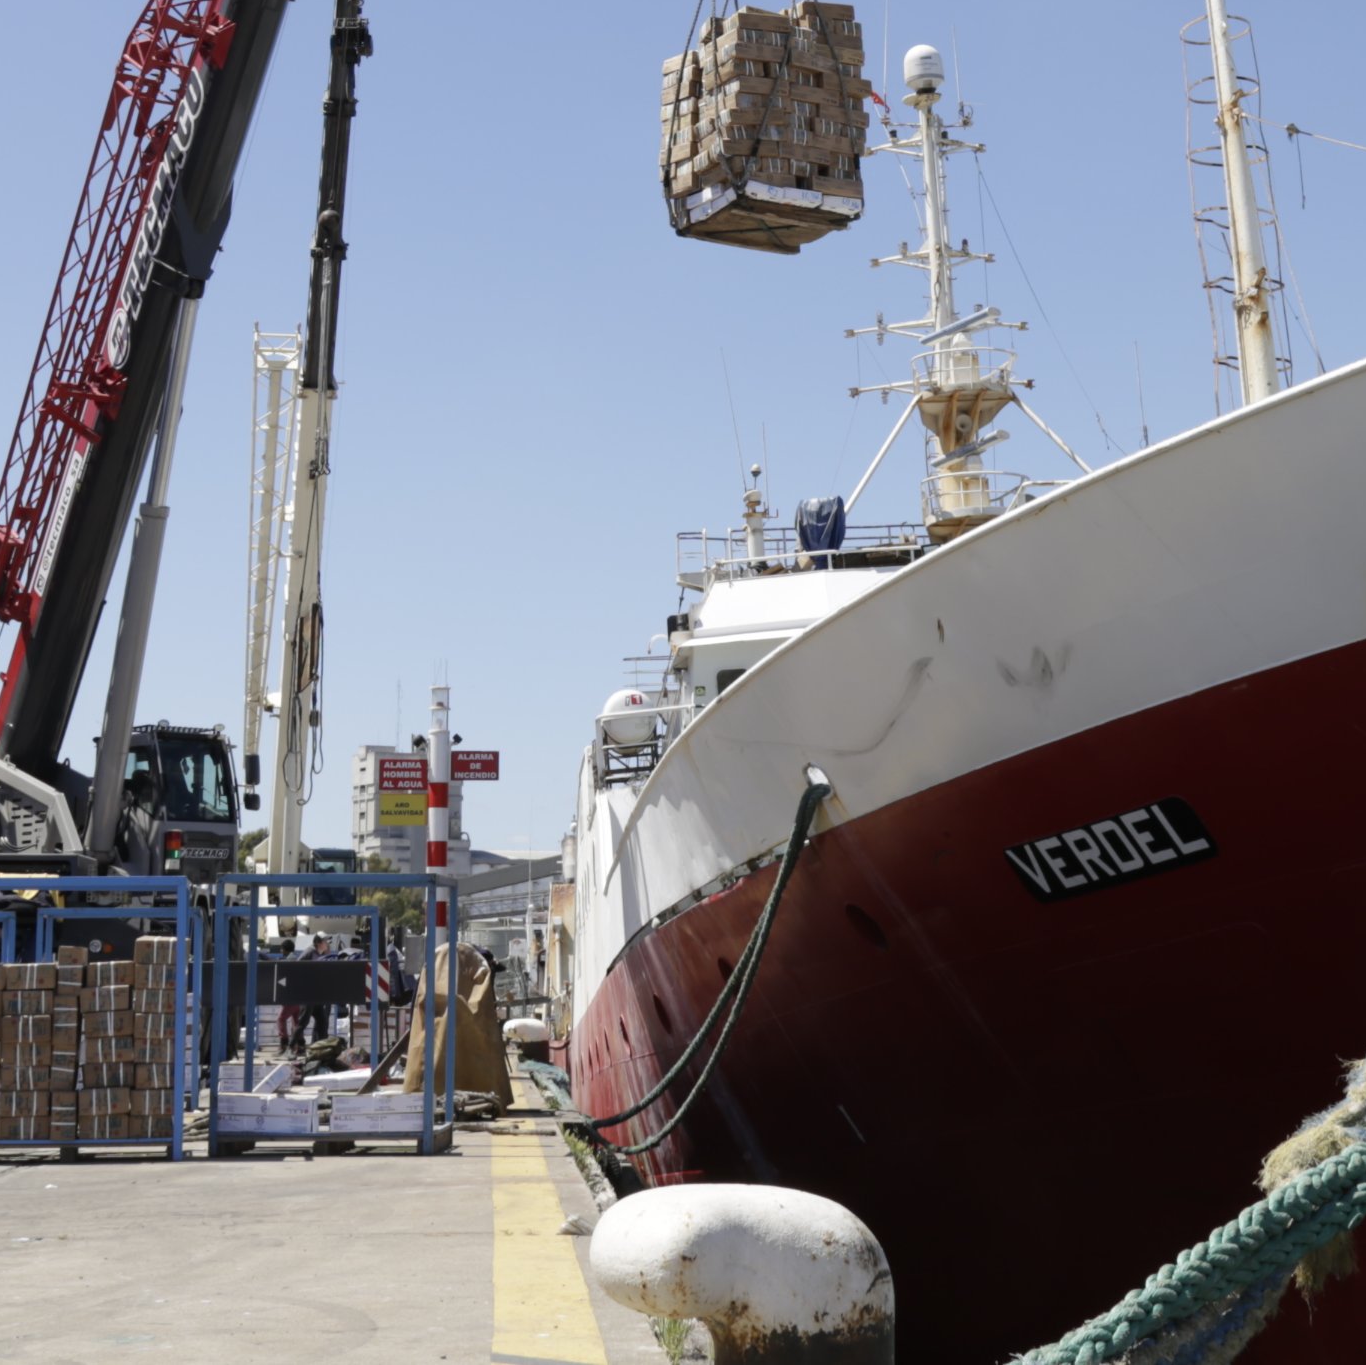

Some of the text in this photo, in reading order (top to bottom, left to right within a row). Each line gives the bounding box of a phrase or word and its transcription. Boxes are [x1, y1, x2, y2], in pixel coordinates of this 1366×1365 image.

[121, 66, 204, 322] TECMACO
[457, 753, 494, 761] ALARMA
[383, 761, 422, 769] ALARMA
[469, 762, 482, 770] DE
[382, 770, 423, 779] HOMBRE
[454, 771, 497, 779] INCENDIO
[382, 780, 423, 788] AL AGUA
[394, 801, 410, 809] ARO
[1005, 804, 1211, 894] VERDEL
[185, 848, 229, 859] TECMACO
